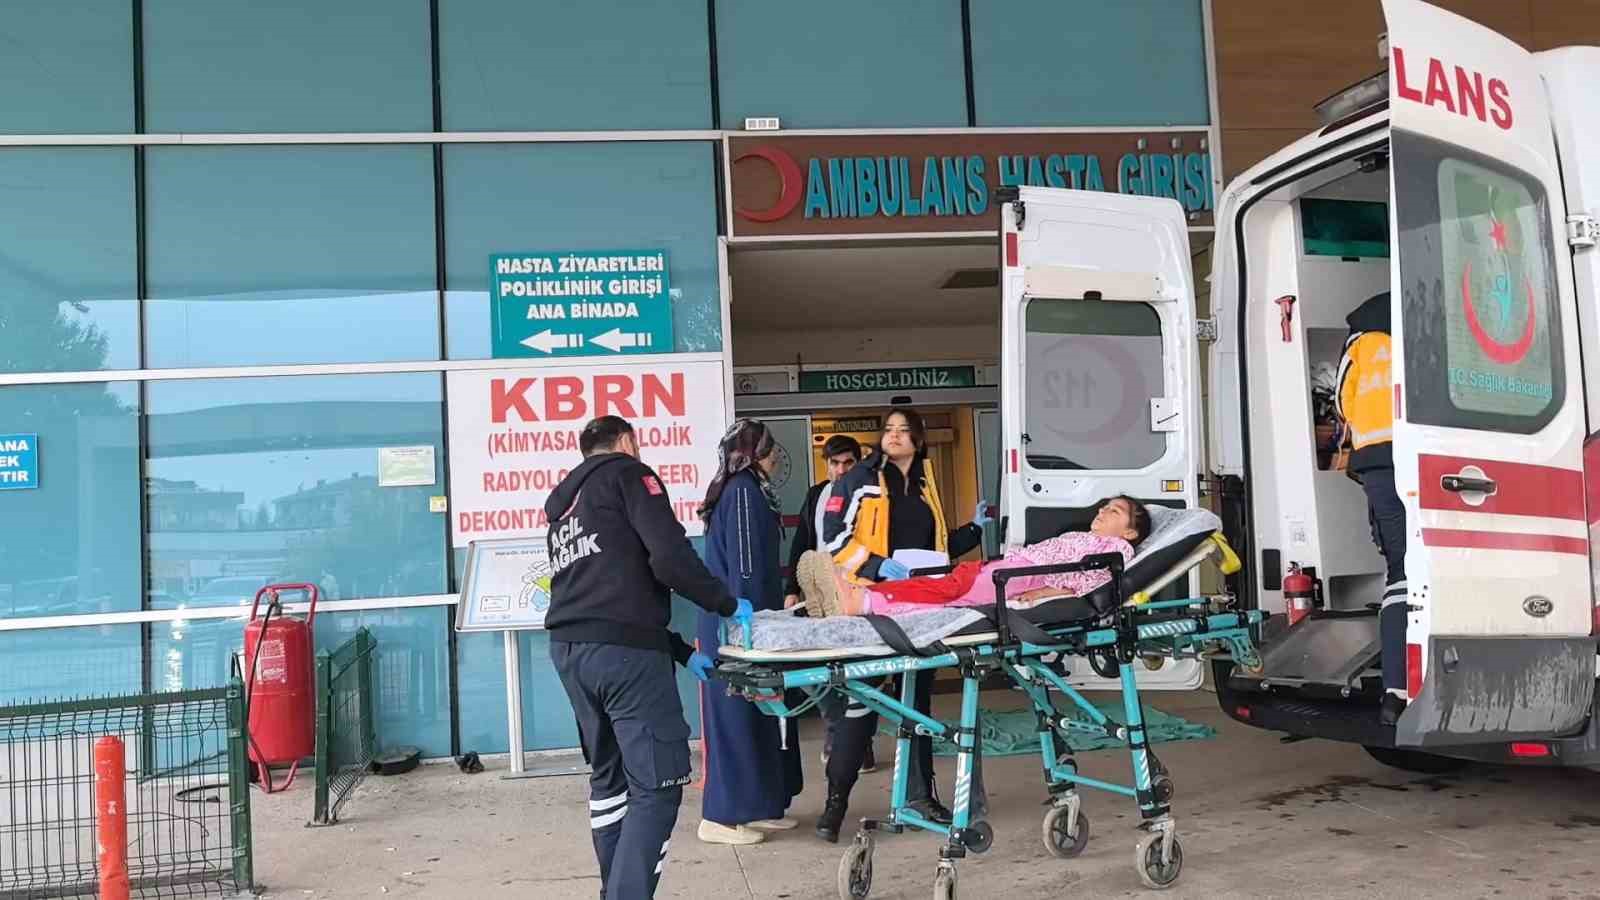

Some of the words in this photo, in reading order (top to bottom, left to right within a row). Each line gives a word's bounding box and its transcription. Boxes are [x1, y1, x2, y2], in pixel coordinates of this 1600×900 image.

[1393, 47, 1513, 130] LANS
[804, 154, 987, 218] AMBULANS
[998, 153, 1104, 192] HASTA
[497, 257, 554, 274] HASTA
[558, 253, 664, 272] ZİYARETLERİ
[500, 276, 605, 297] POLİKLİNİK
[608, 274, 663, 298] GİRİŞİ
[527, 303, 566, 320] ANA
[571, 299, 640, 319] BİNADA
[826, 368, 951, 391] HOŞGELDİNİZ
[490, 373, 686, 423] KBRN
[487, 428, 580, 459] (KİMYASA
[483, 468, 569, 493] RADYOLO
[658, 463, 698, 488] EER)
[459, 508, 549, 533] DEKONTA
[551, 532, 602, 577] AĞLIK
